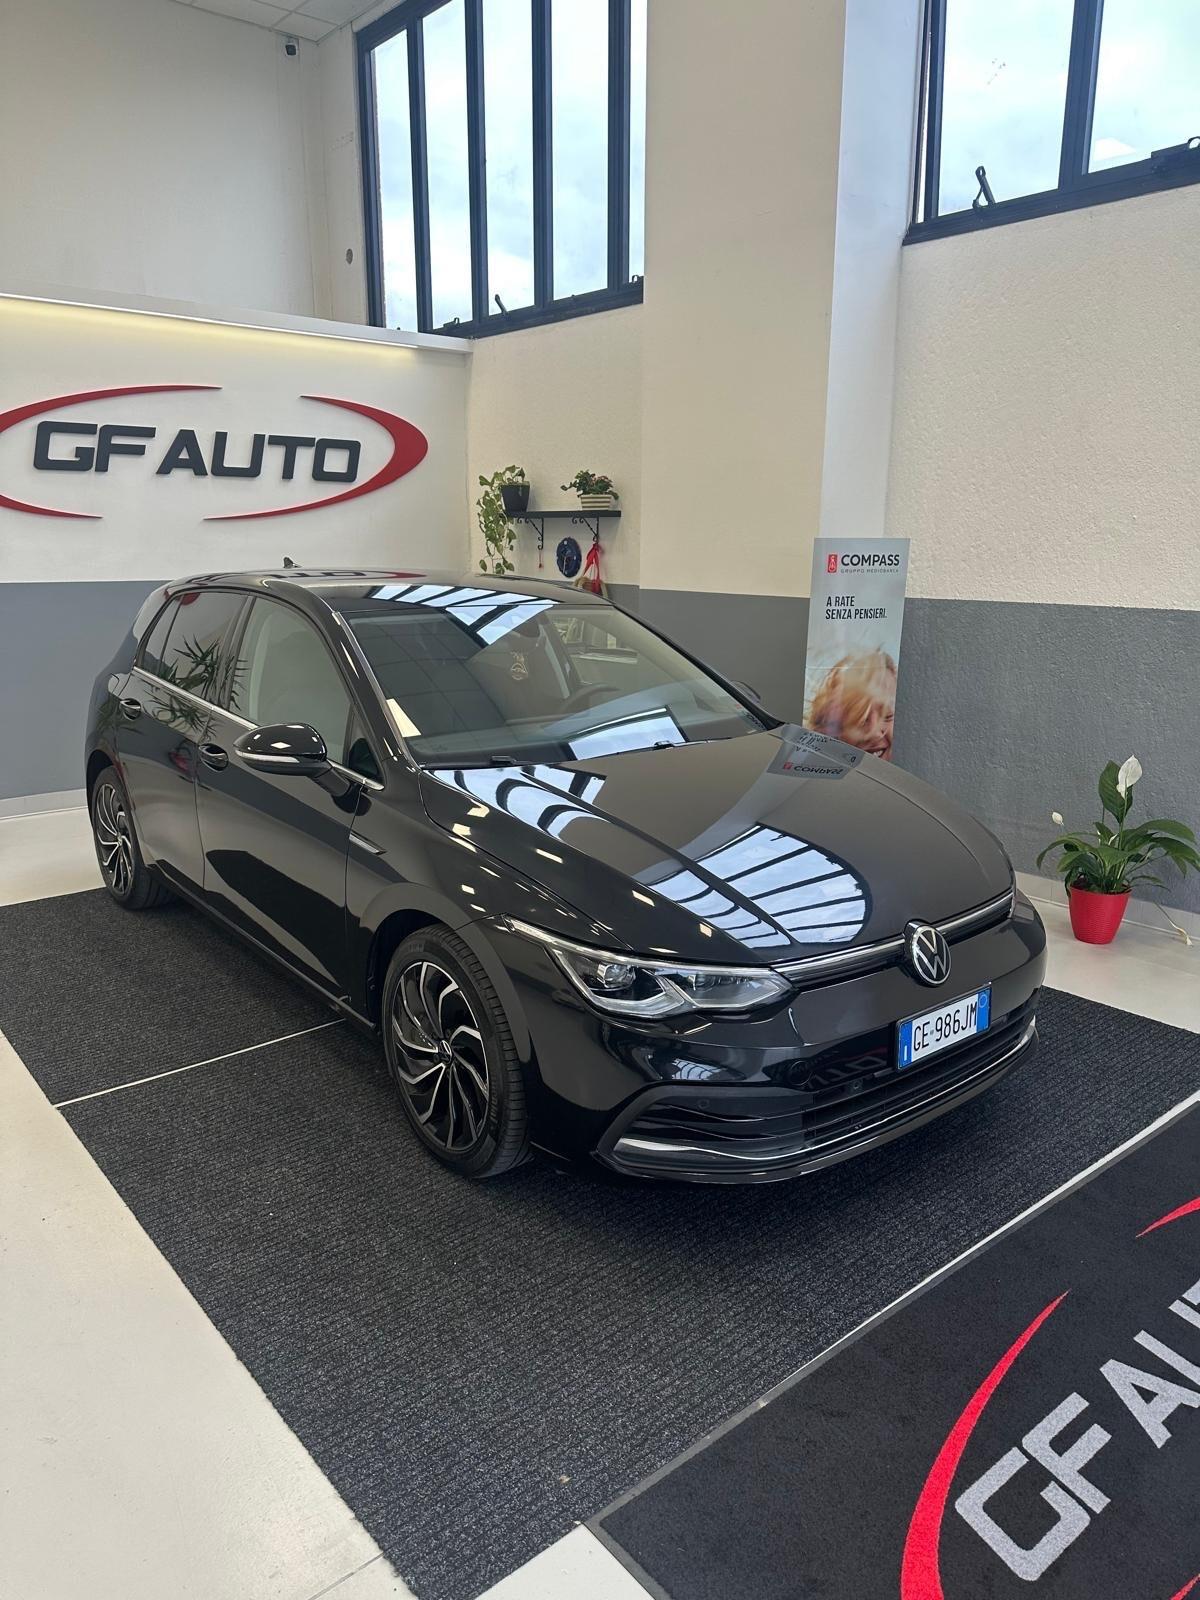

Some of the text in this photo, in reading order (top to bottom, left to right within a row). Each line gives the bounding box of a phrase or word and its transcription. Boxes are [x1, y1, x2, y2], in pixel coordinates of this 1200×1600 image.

[33, 420, 361, 483] GF AUTO
[841, 554, 900, 567] COMPASS
[826, 595, 855, 607] A RATE
[825, 607, 888, 620] SENZA PENSIERI.
[954, 1391, 1112, 1581] GF
